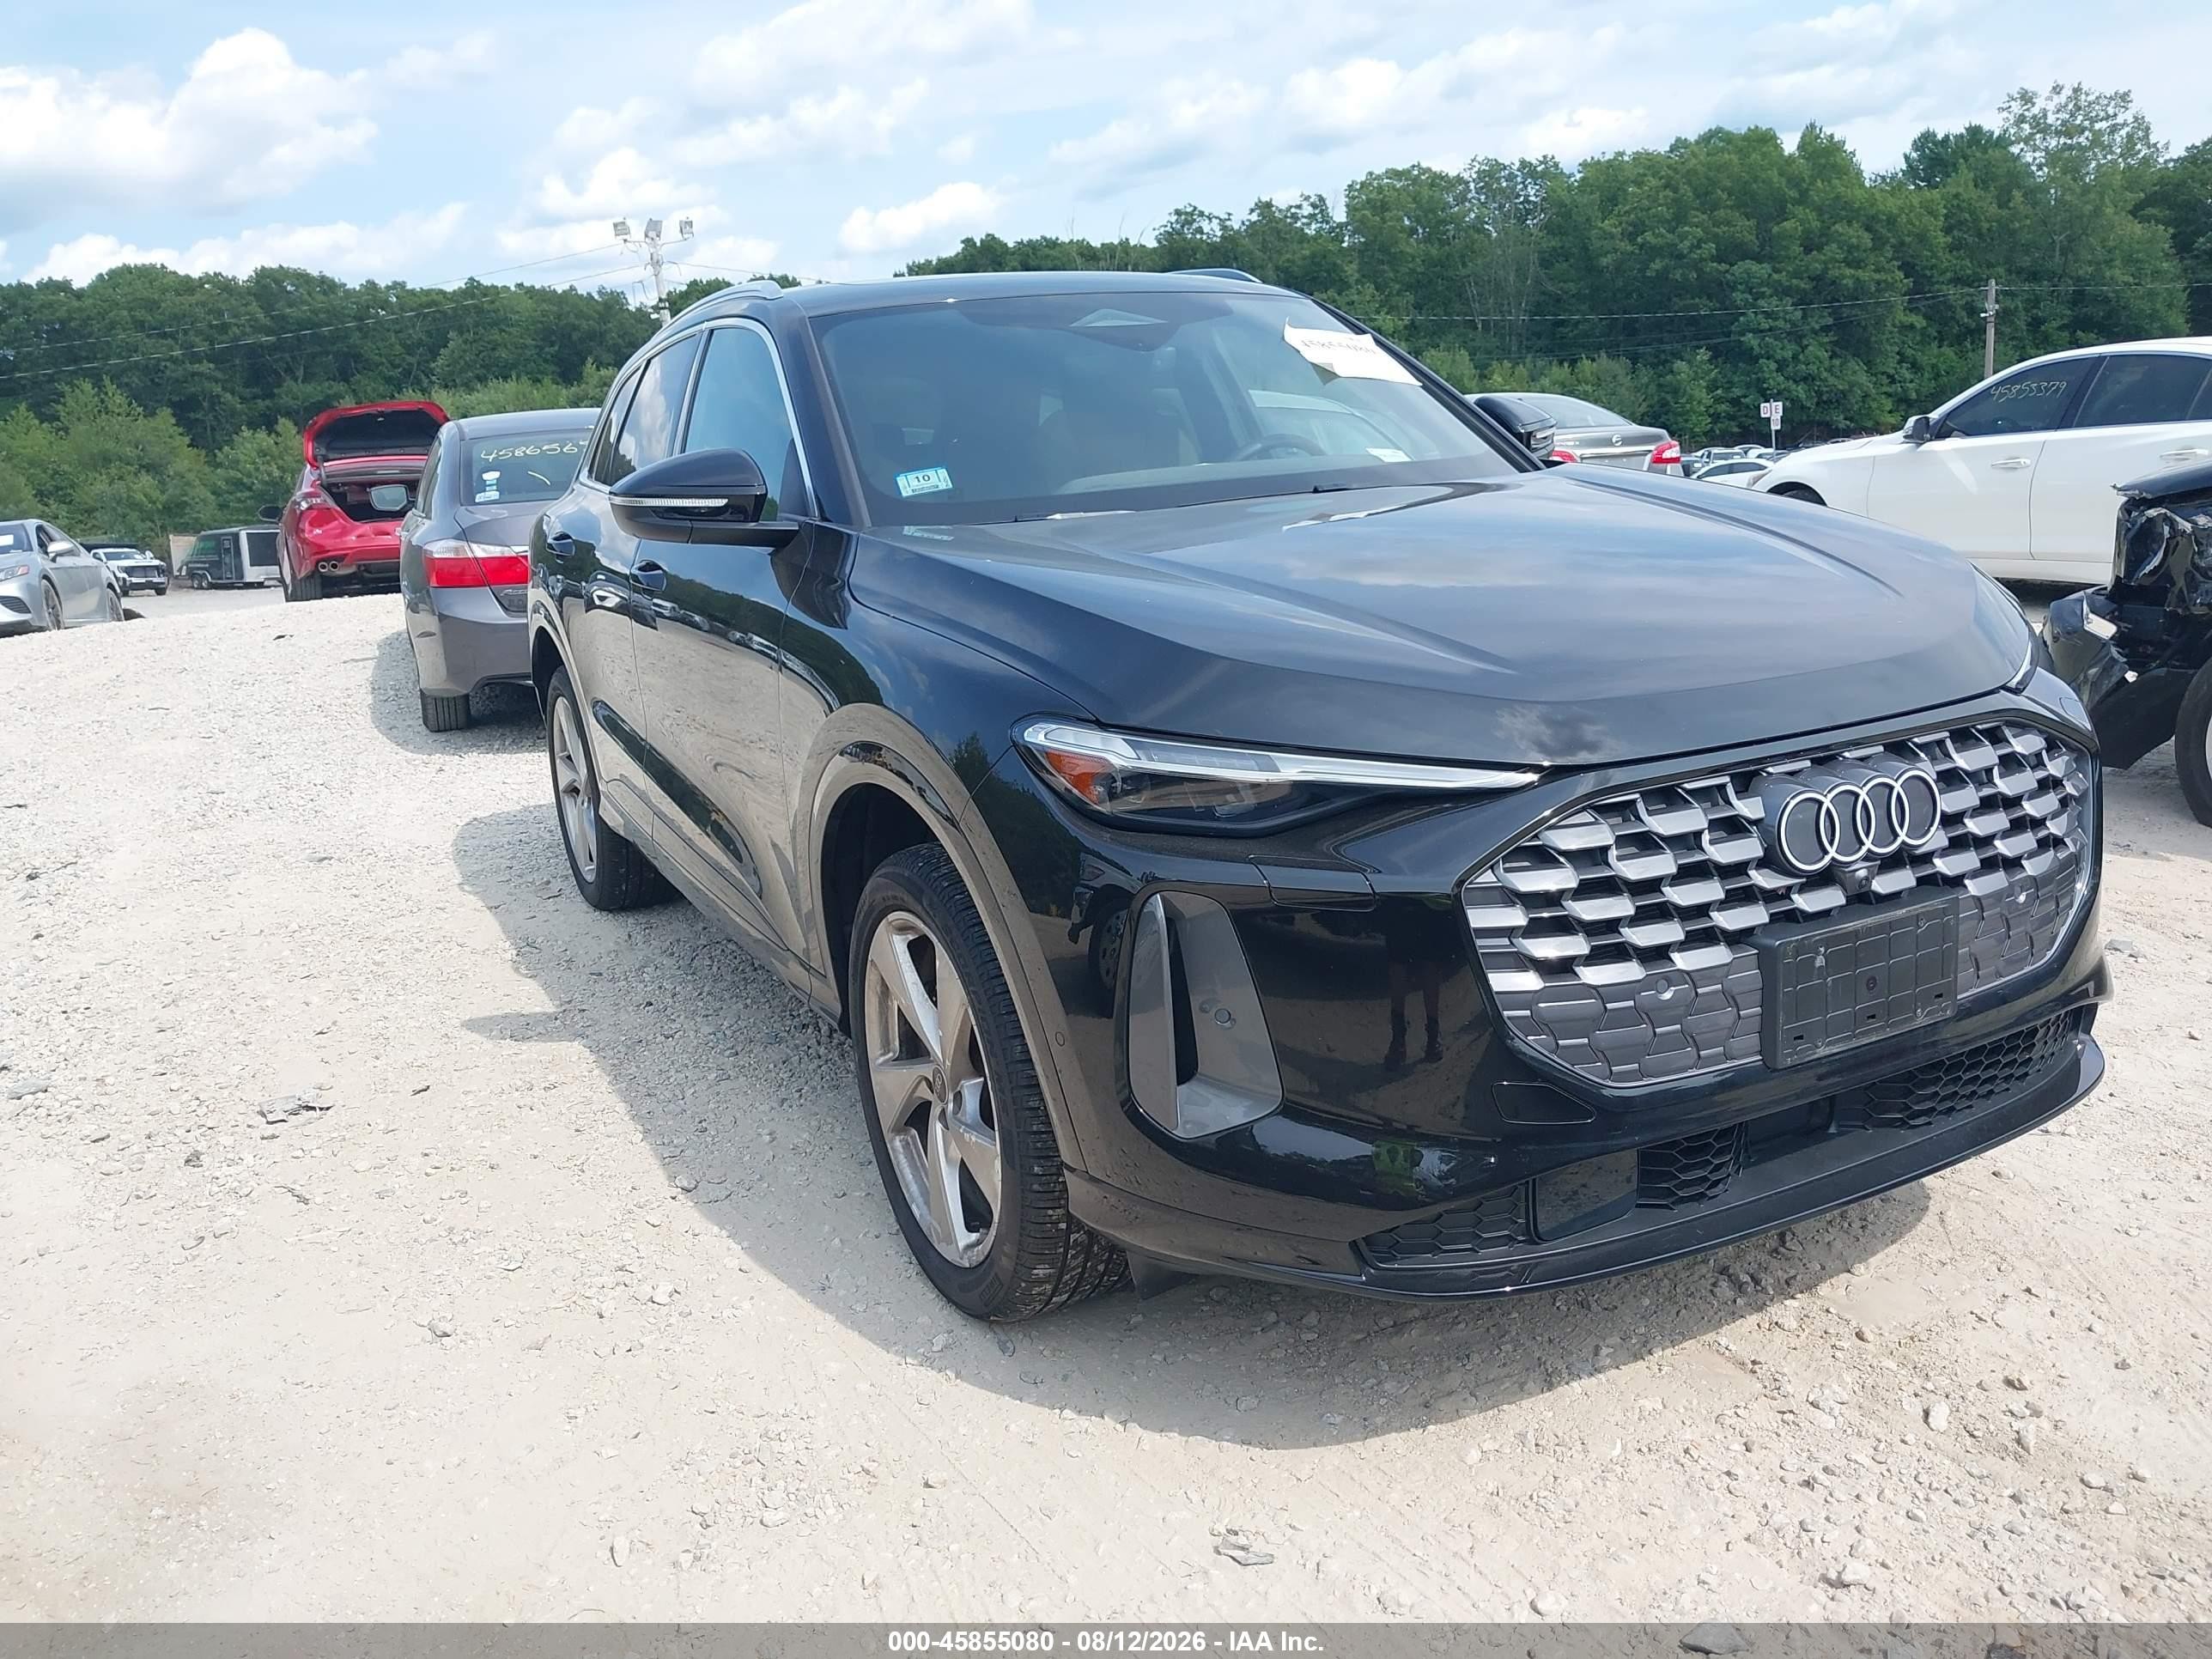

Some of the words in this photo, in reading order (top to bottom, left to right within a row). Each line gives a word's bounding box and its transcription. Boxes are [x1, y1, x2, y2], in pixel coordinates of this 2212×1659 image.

[1763, 405, 1769, 416] D
[1774, 404, 1780, 414] E
[915, 474, 931, 483] 10
